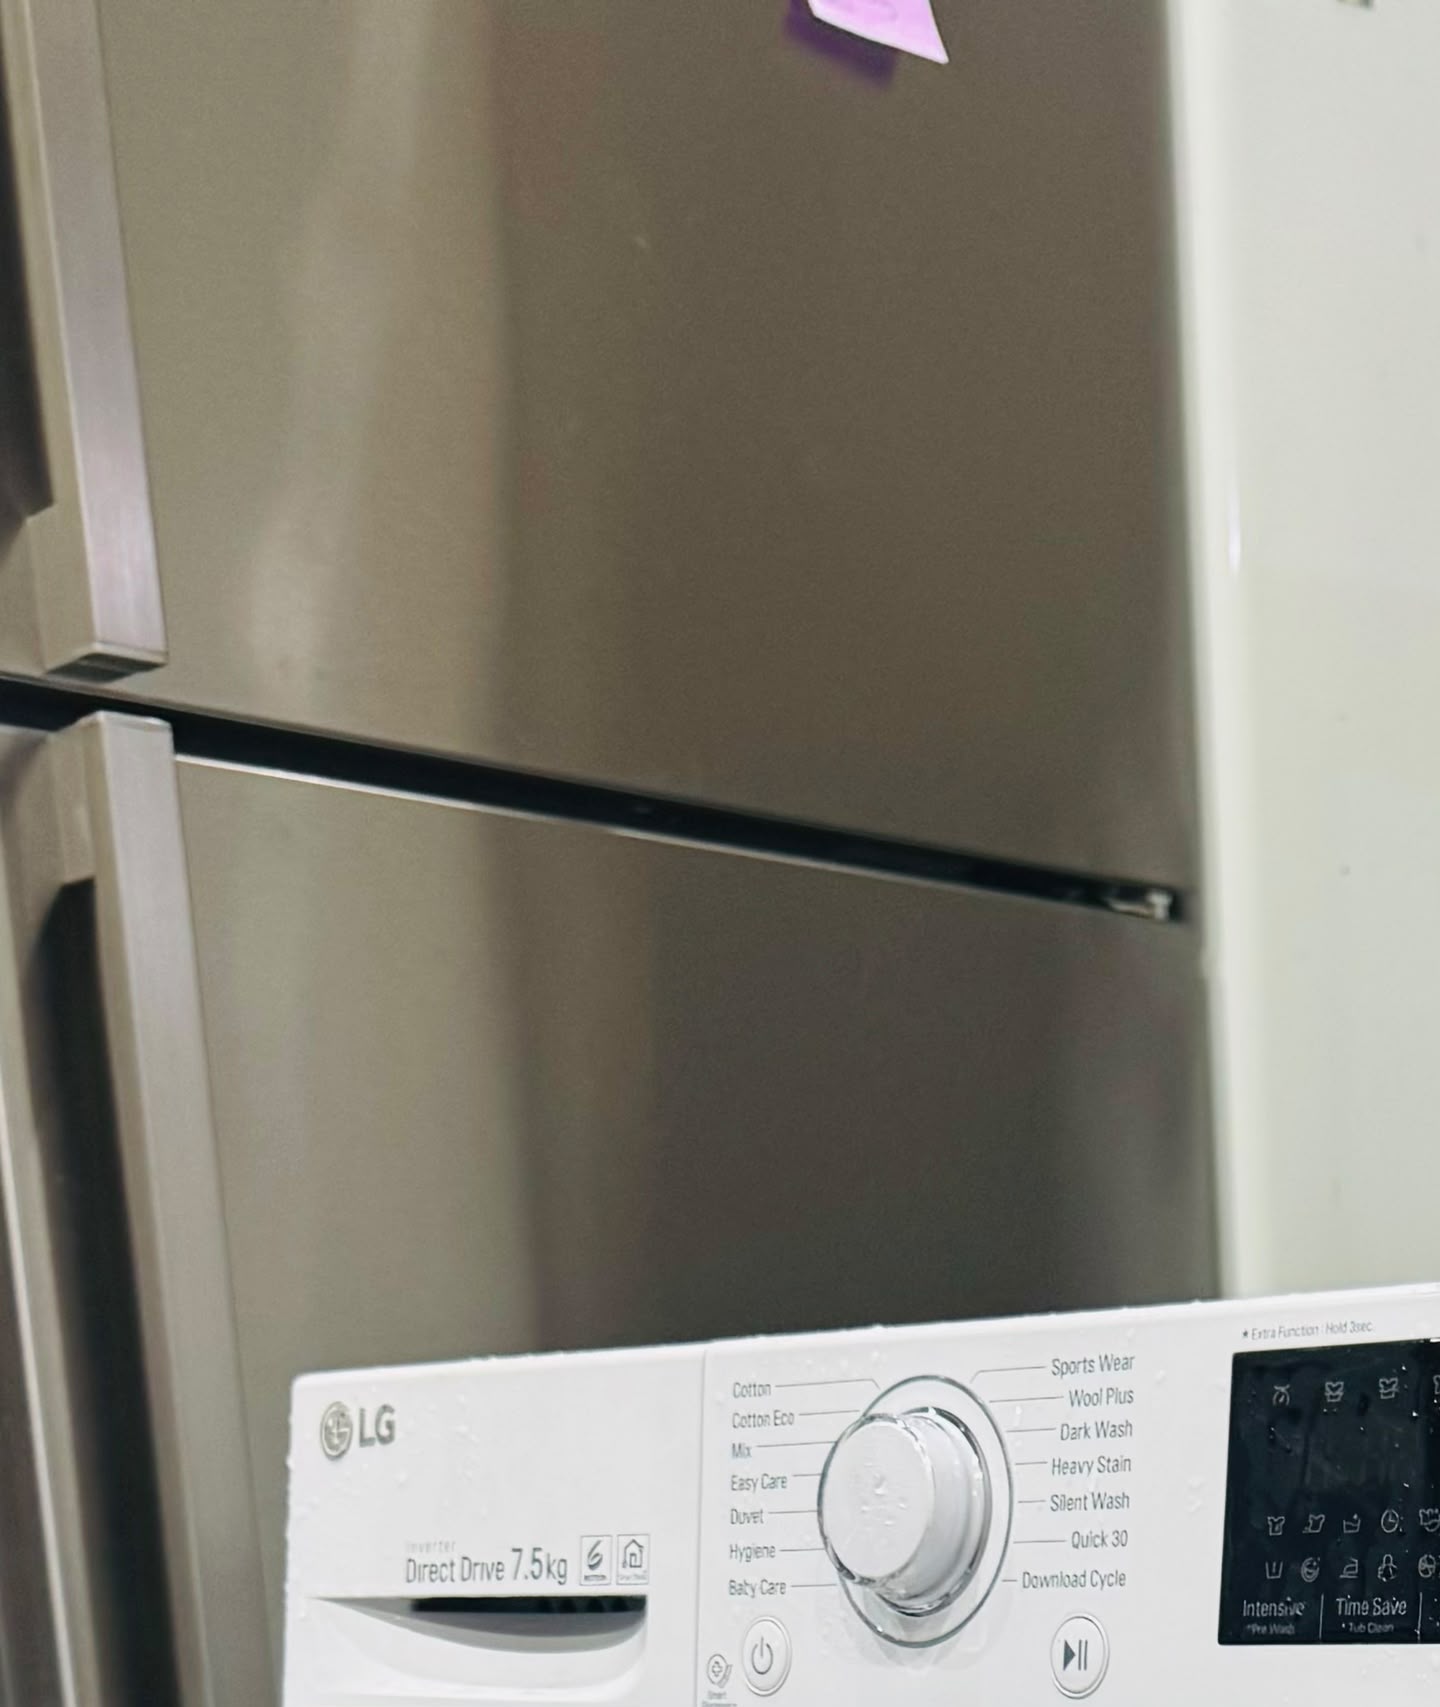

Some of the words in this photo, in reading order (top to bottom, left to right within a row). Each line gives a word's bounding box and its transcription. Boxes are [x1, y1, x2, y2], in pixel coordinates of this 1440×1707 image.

[1252, 1327, 1276, 1341] Extra
[1278, 1325, 1319, 1339] Function
[1326, 1321, 1348, 1335] Hold
[1051, 1356, 1096, 1379] Sports
[1099, 1354, 1135, 1373] Wear
[732, 1382, 771, 1399] Cotton
[1068, 1387, 1103, 1408] Wool
[1106, 1387, 1135, 1406] Plus
[732, 1412, 771, 1429] Cotton
[773, 1409, 795, 1426] Eco
[1060, 1422, 1091, 1441] Dark
[1095, 1419, 1133, 1439] Wash
[731, 1442, 752, 1459] Mix
[1052, 1456, 1094, 1477] Heavy
[1097, 1455, 1132, 1474] Stain
[731, 1474, 759, 1493] Easy
[761, 1472, 788, 1489] Care
[1050, 1493, 1088, 1512] Silent
[1091, 1491, 1130, 1511] Wash
[730, 1508, 764, 1525] Duvet
[1071, 1529, 1109, 1549] Quick
[1111, 1529, 1129, 1549] 30
[729, 1543, 776, 1563] Hygiene
[406, 1557, 456, 1584] Direct
[460, 1556, 505, 1583] Drive
[1022, 1570, 1087, 1589] Download
[1090, 1569, 1127, 1591] Cycle
[729, 1579, 757, 1599] Baby
[760, 1578, 787, 1595] Care
[1242, 1597, 1305, 1618] Intensive
[1336, 1595, 1369, 1617] Time
[1372, 1596, 1407, 1616] Save
[1348, 1622, 1366, 1633] Tub
